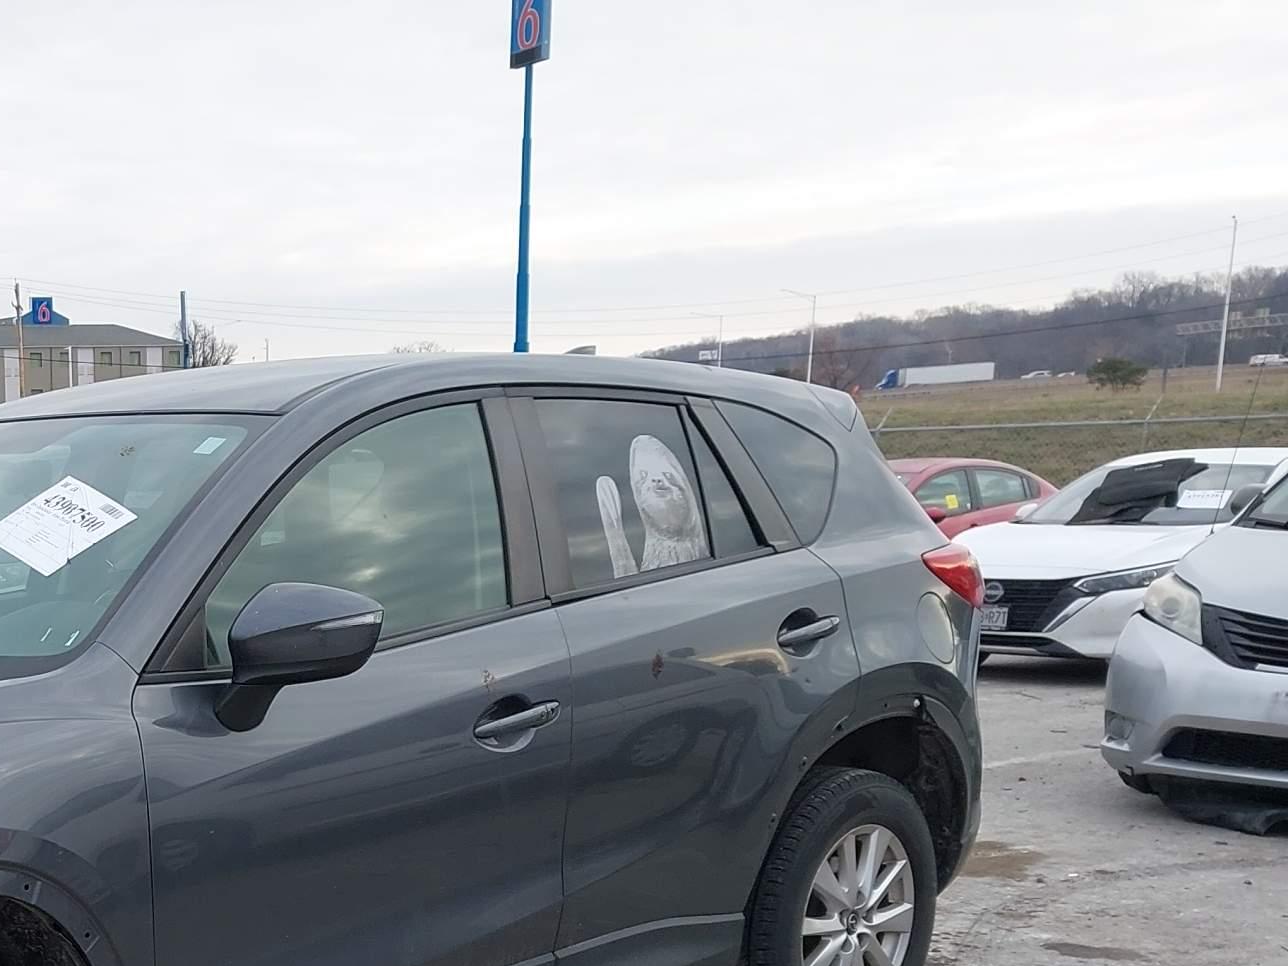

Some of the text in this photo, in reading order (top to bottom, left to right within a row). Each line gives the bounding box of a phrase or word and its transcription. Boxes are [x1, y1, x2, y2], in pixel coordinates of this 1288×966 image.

[517, 0, 540, 50] 6
[37, 301, 50, 322] 6
[43, 494, 105, 533] 43907500
